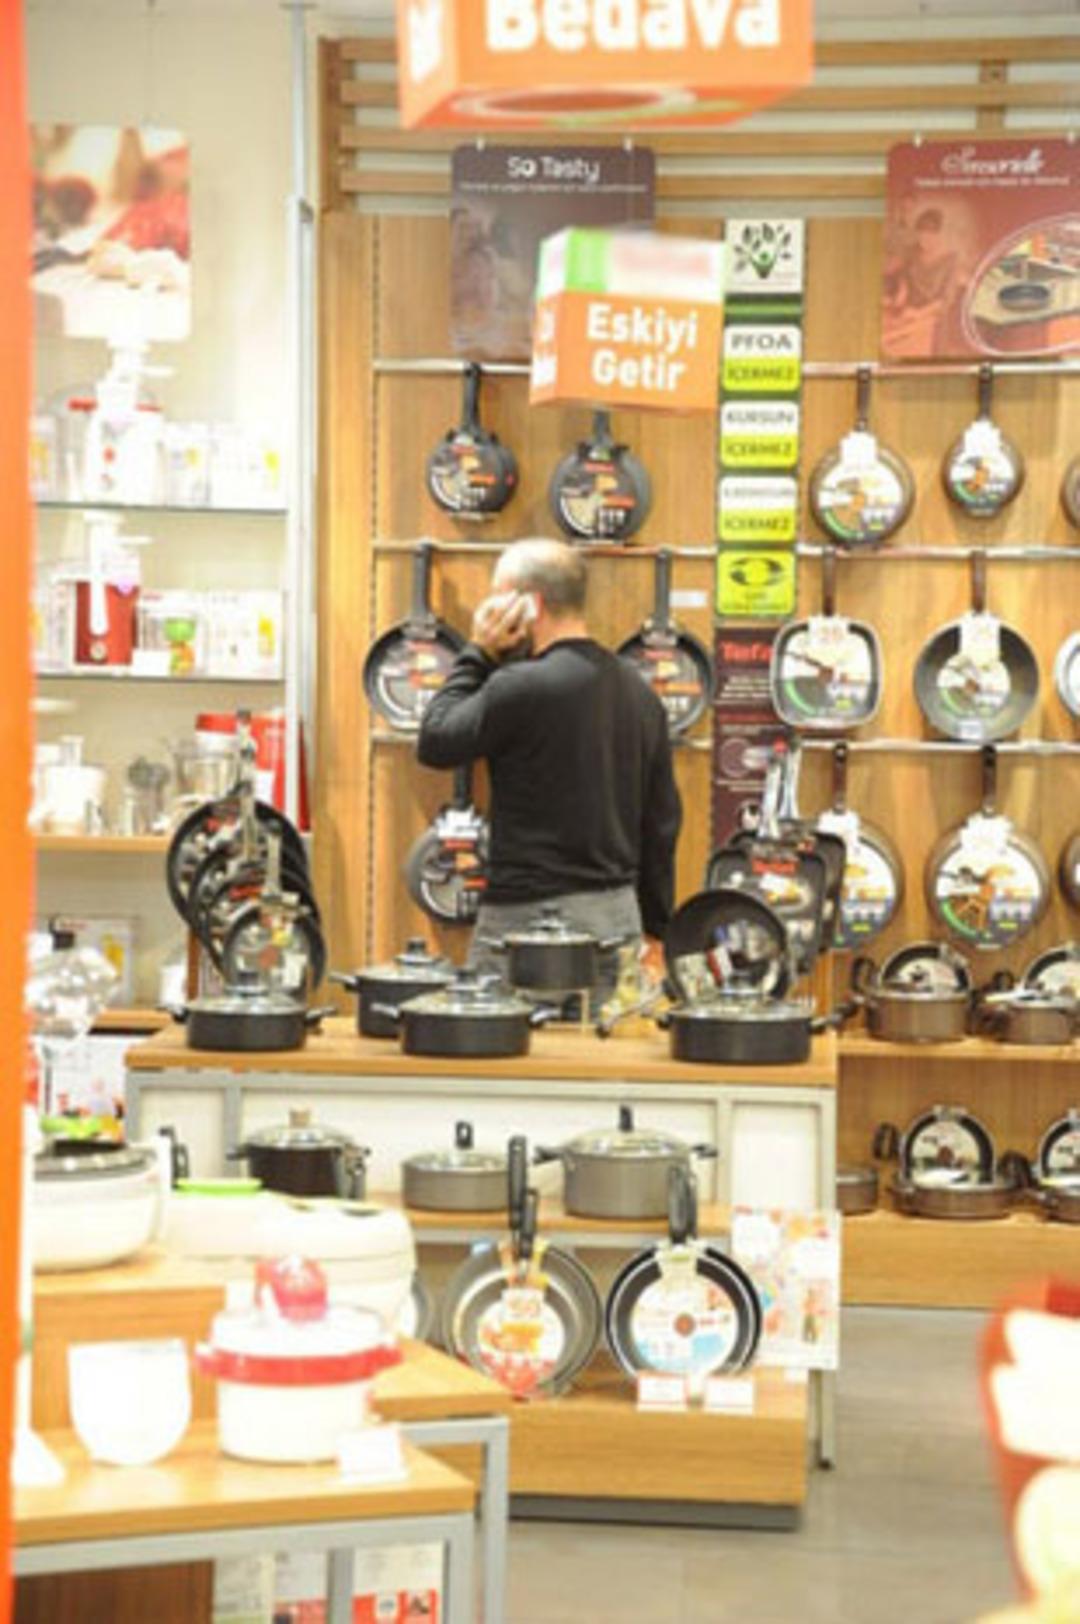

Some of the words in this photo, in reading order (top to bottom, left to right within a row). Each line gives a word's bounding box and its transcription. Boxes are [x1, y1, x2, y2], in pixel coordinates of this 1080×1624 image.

[586, 303, 698, 355] Eskiyi
[731, 333, 793, 351] PFOA
[592, 348, 686, 391] Getir
